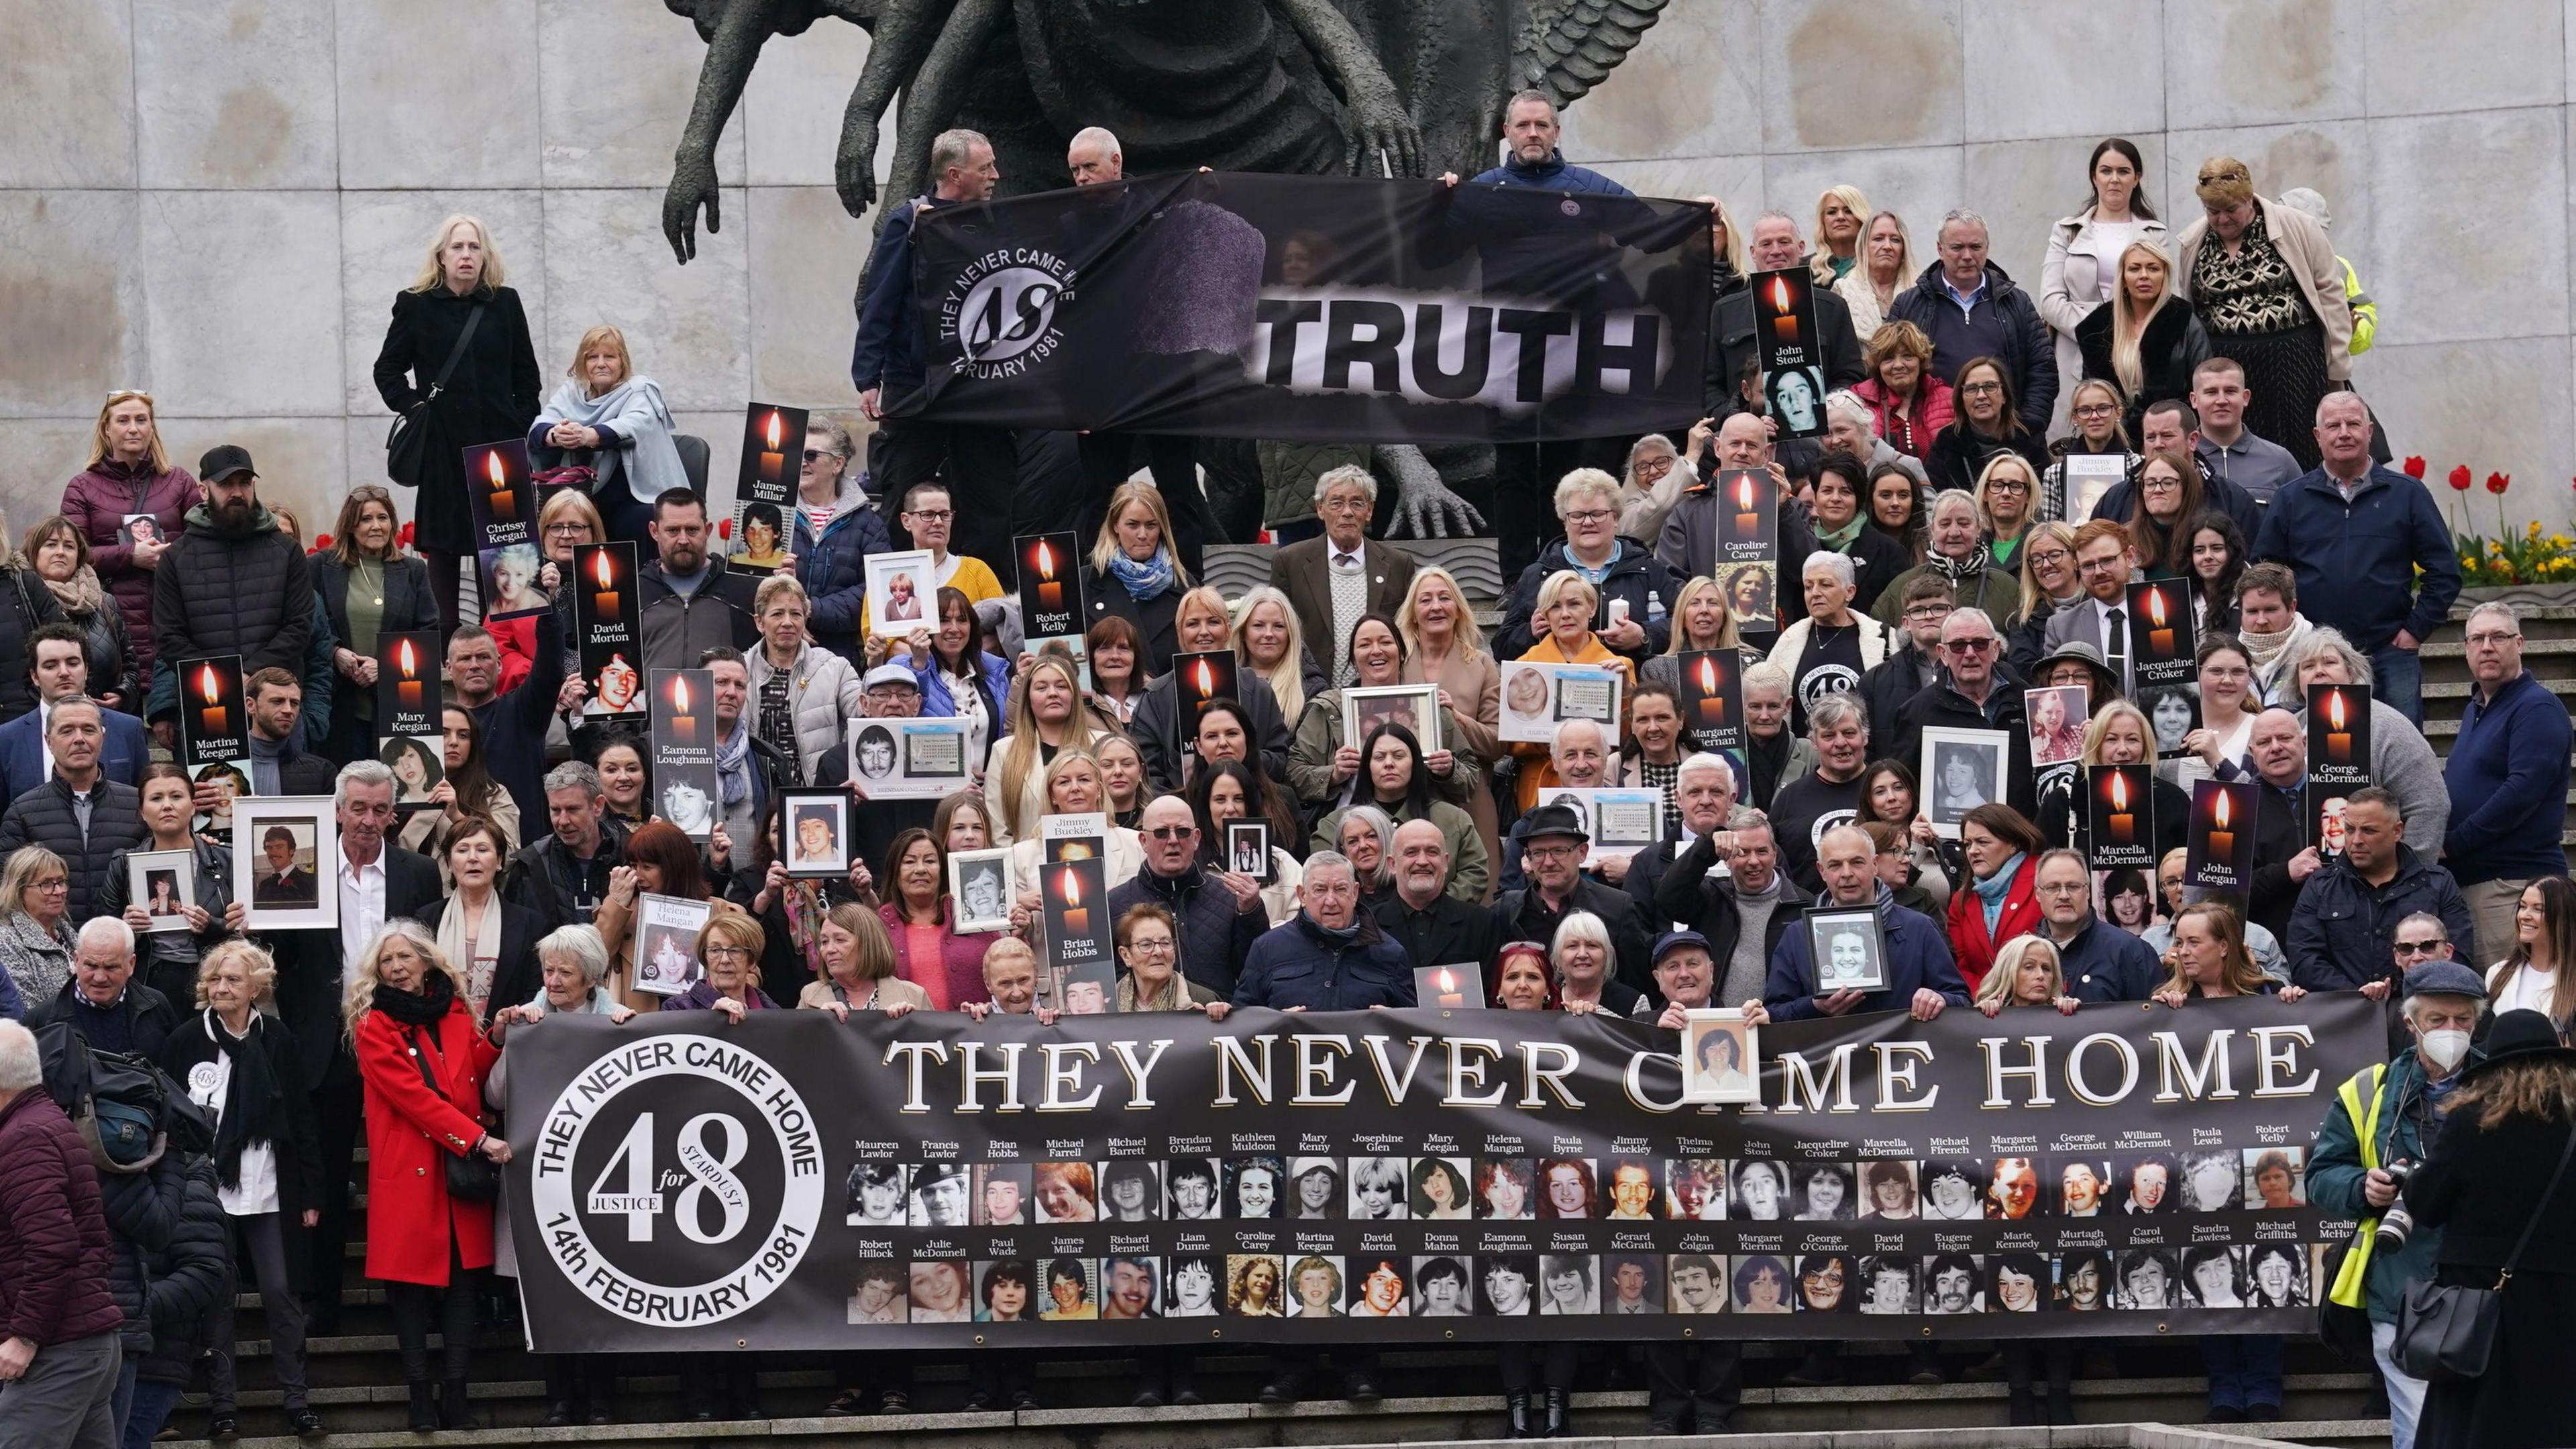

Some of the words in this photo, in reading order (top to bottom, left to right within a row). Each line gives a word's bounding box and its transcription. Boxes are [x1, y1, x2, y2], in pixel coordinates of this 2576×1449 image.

[941, 290, 961, 340] THEY
[955, 250, 1011, 290] NEVER
[1016, 248, 1066, 276] CAME
[1030, 327, 1064, 363] 1981
[1256, 298, 1660, 403] TRUTH
[1776, 346, 1802, 356] John
[1776, 355, 1804, 365] Stout
[2078, 458, 2110, 466] Jimmy
[2077, 466, 2113, 474] Buckley
[753, 480, 786, 492] James
[754, 490, 784, 500] Millar
[486, 522, 526, 533] Chrissy
[489, 531, 527, 543] Keegan
[1725, 541, 1768, 550] Caroline
[1731, 551, 1761, 559] Carey
[1036, 612, 1070, 623] Robert
[594, 623, 624, 633] David
[1041, 622, 1066, 632] Kelly
[591, 634, 629, 643] Morton
[2136, 659, 2194, 671] Jacqueline
[2148, 669, 2184, 680] Croker
[1800, 678, 1808, 695] THEY
[1808, 665, 1831, 678] NEVER
[1831, 665, 1851, 676] CAME
[398, 713, 425, 722] Mary
[392, 722, 431, 733] Keegan
[1692, 727, 1737, 739] Margaret
[196, 739, 238, 749] Martina
[199, 749, 237, 759] Keegan
[663, 746, 706, 754] Eamonn
[657, 755, 712, 766] Loughman
[2320, 764, 2358, 775] George
[2310, 773, 2369, 783] McDermott
[1056, 818, 1090, 828] Jimmy
[1055, 826, 1094, 837] Buckley
[2100, 845, 2145, 855] Marcella
[2092, 854, 2153, 865] McDermott
[2204, 863, 2231, 873] John
[2198, 872, 2237, 885] Keegan
[658, 903, 692, 916] Helena
[656, 913, 693, 927] Mangan
[1064, 939, 1093, 949] Brian
[1063, 948, 1097, 959] Hobbs
[883, 1039, 1173, 1114] THEY
[1210, 1033, 1585, 1110] NEVER
[1623, 1040, 1941, 1114] CME
[1976, 1024, 2321, 1110] HOME
[198, 1072, 213, 1084] 48
[539, 1098, 583, 1178] THEY
[577, 1042, 676, 1104] NEVER
[685, 1042, 771, 1095] CAME
[765, 1088, 818, 1177] HOME
[2193, 1128, 2221, 1136] Paula
[2255, 1125, 2289, 1133] Robert
[1232, 1133, 1275, 1141] Kathleen
[1303, 1133, 1327, 1144] Mary
[1352, 1134, 1403, 1145] Josephine
[1429, 1134, 1453, 1144] Mary
[1487, 1135, 1521, 1143] Helena
[2060, 1134, 2095, 1143] George
[2123, 1131, 2161, 1139] William
[2261, 1134, 2286, 1143] Kelly
[856, 1140, 898, 1148] Maureen
[990, 1140, 1016, 1148] Brian
[1046, 1139, 1083, 1148] Michael
[1108, 1138, 1146, 1146] Michael
[1169, 1136, 1212, 1144] Brendan
[1554, 1136, 1582, 1144] Paula
[1613, 1136, 1648, 1146] Jimmy
[1676, 1137, 1713, 1145] Thelma
[1864, 1138, 1907, 1146] Marcella
[1930, 1137, 1969, 1145] Michael
[1991, 1136, 2036, 1145] Margaret
[2115, 1139, 2171, 1148] McDermott
[2194, 1137, 2222, 1145] Lewis
[1170, 1145, 1211, 1153] O'Meara
[1233, 1142, 1275, 1150] Muldoon
[1299, 1142, 1330, 1152] Kenny
[1366, 1140, 1389, 1151] Glen
[1424, 1143, 1458, 1153] Keegan
[1485, 1144, 1524, 1155] Mangan
[1554, 1144, 1582, 1155] Byrne
[1680, 1145, 1711, 1153] Frazer
[1794, 1140, 1849, 1150] Jacqueline
[1990, 1144, 2037, 1152] Thornton
[2051, 1142, 2106, 1151] McDermott
[861, 1150, 894, 1158] Lawlor
[924, 1150, 957, 1158] Lawlor
[988, 1149, 1018, 1157] Hobbs
[1050, 1148, 1081, 1157] Farrell
[1110, 1147, 1144, 1155] Barrett
[1611, 1145, 1651, 1155] Buckley
[1805, 1149, 1839, 1157] Croker
[1858, 1147, 1914, 1156] McDermott
[1931, 1146, 1969, 1154] Ffrench
[588, 1112, 749, 1244] 48
[592, 1197, 658, 1211] JUSTICE
[655, 1169, 688, 1191] for
[682, 1144, 743, 1208] STARDUST
[2193, 1224, 2229, 1233] Sandra
[2257, 1221, 2295, 1230] Michael
[1236, 1232, 1275, 1240] Caroline
[1615, 1232, 1650, 1240] Gerard
[2061, 1230, 2103, 1239] Murtagh
[2133, 1227, 2159, 1236] Carol
[2255, 1230, 2297, 1239] Griffiths
[1110, 1235, 1148, 1244] Richard
[1181, 1233, 1205, 1241] Liam
[1296, 1232, 1334, 1241] Martina
[1426, 1233, 1458, 1241] Donna
[1485, 1233, 1526, 1241] Eamonn
[1739, 1234, 1782, 1243] Margaret
[1807, 1234, 1841, 1244] George
[1875, 1234, 1903, 1242] David
[1935, 1234, 1972, 1243] Eugene
[2130, 1236, 2163, 1244] Bissett
[2192, 1233, 2231, 1242] Lawless
[861, 1240, 892, 1248] Robert
[926, 1240, 951, 1248] Julie
[992, 1238, 1014, 1246] Paul
[1177, 1242, 1210, 1250] Dunne
[1242, 1241, 1269, 1251] Carey
[1361, 1242, 1396, 1250] Morton
[1551, 1242, 1588, 1251] Morgan
[1680, 1242, 1714, 1251] Colgan
[1741, 1242, 1780, 1250] Kiernan
[1937, 1242, 1969, 1251] Hogan
[1996, 1240, 2039, 1249] Kennedy
[2058, 1238, 2107, 1248] Kavanagh
[989, 1247, 1016, 1255] Wade
[1055, 1245, 1083, 1253] Millar
[1111, 1244, 1149, 1252] Bennett
[1298, 1242, 1332, 1252] Keegan
[1479, 1242, 1532, 1252] Loughman
[859, 1249, 893, 1257] Hillock
[913, 1248, 965, 1257] McDonnell
[547, 1212, 588, 1275] 14th
[585, 1267, 751, 1322] FEBRUARY
[754, 1223, 806, 1283] 1981
